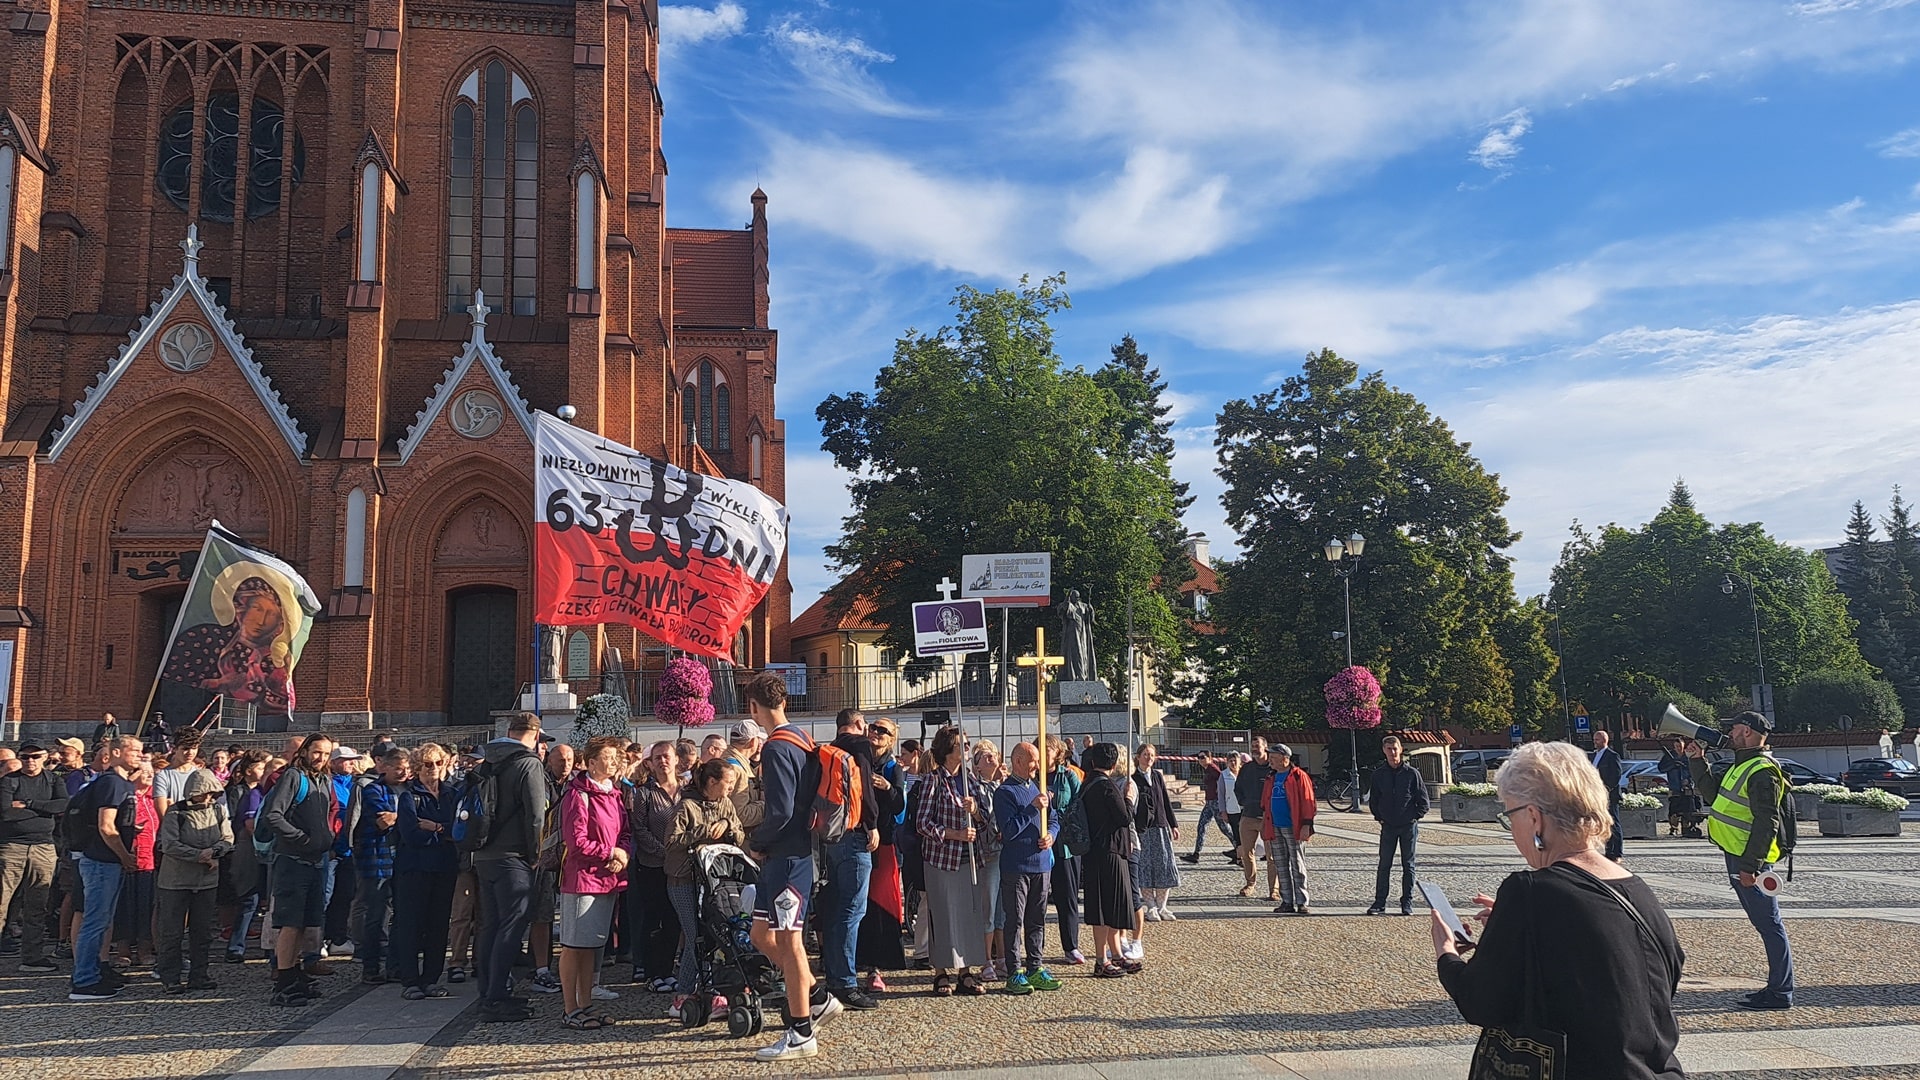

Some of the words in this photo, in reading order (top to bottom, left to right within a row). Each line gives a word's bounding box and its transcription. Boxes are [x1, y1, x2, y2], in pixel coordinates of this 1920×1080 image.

[542, 454, 641, 484] NIEZŁOMNYM
[546, 488, 605, 535] 63
[702, 525, 772, 584] DNI
[557, 600, 601, 616] CZEŚĆ
[609, 600, 666, 630] CHWAŁA
[1513, 724, 1520, 732] P
[1578, 718, 1586, 727] P
